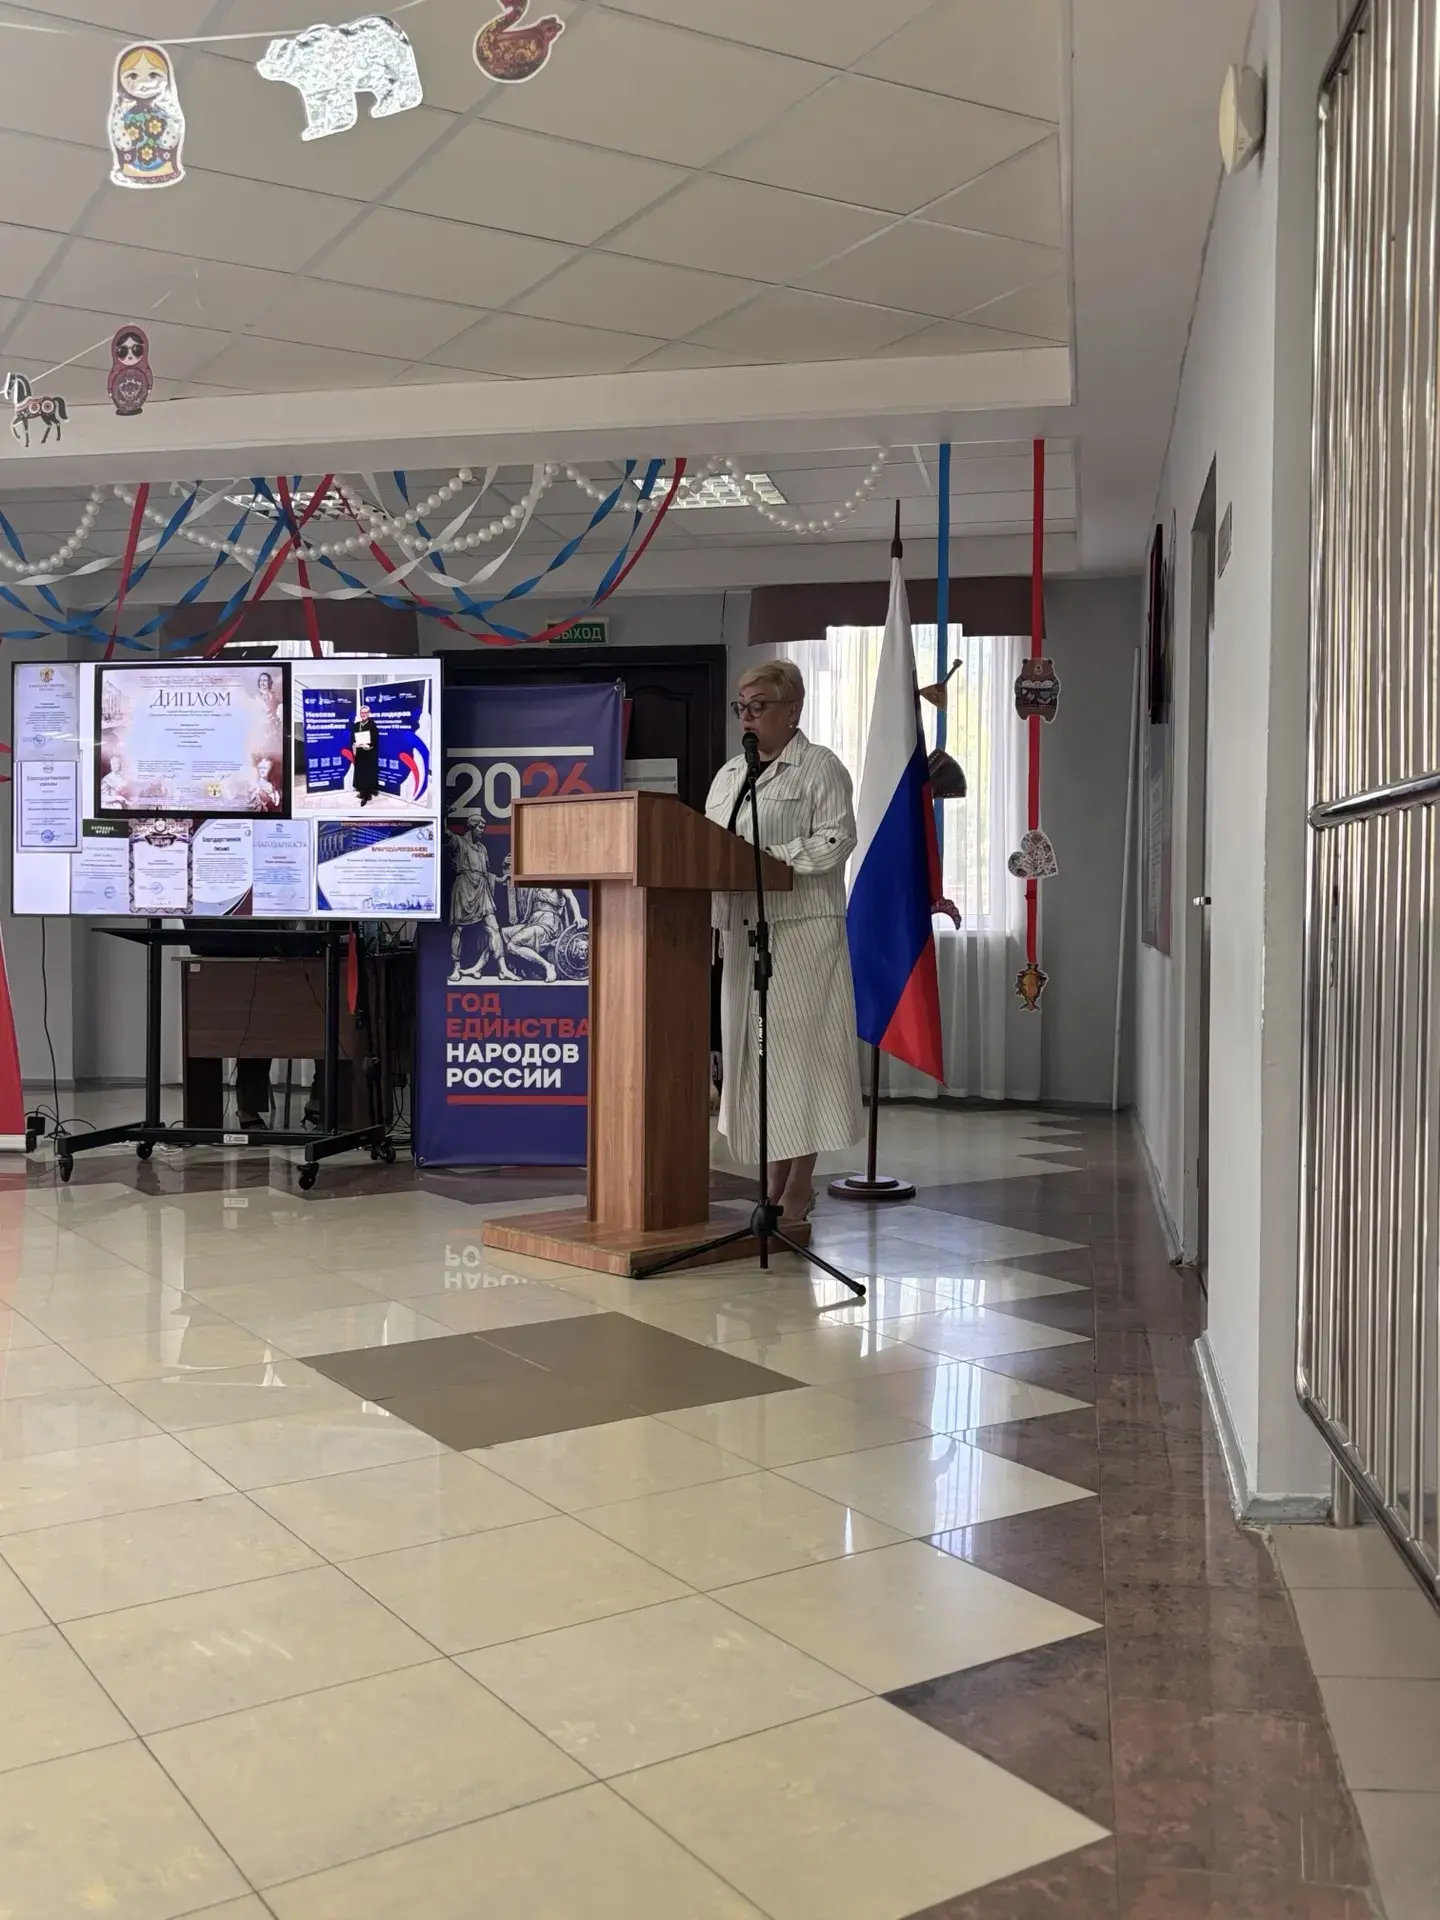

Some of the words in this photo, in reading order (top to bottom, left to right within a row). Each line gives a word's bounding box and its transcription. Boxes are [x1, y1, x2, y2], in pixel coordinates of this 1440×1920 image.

[553, 627, 602, 640] ЫХОД
[149, 689, 231, 709] ДИПЛОМ
[446, 761, 594, 818] 2026
[446, 993, 501, 1015] ГОД
[446, 1018, 589, 1040] ЕДИНСТВА
[446, 1043, 580, 1066] НАРОДОВ
[446, 1068, 562, 1088] РОССИИ
